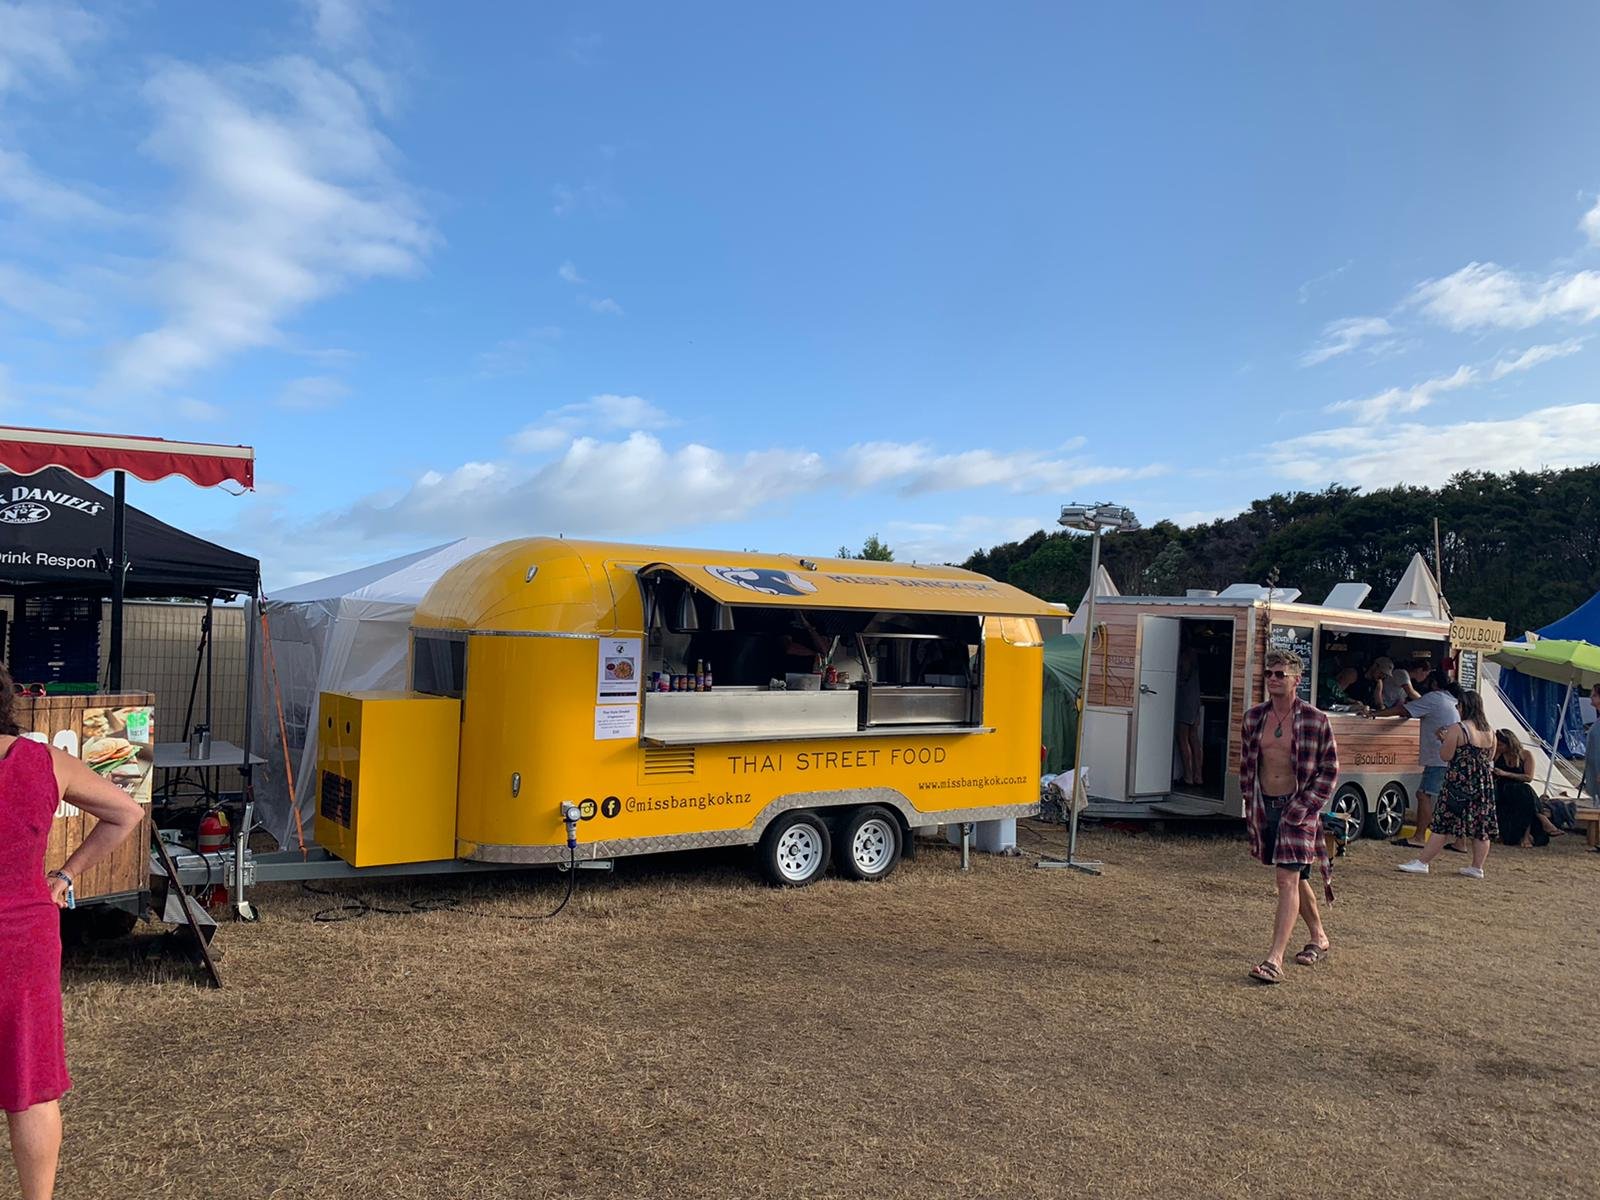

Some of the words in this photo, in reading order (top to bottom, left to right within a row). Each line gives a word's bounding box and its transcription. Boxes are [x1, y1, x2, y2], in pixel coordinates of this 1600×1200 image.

[11, 486, 105, 516] DANIEL'S
[1451, 625, 1502, 643] SOULBOUL
[728, 756, 782, 774] THAI
[796, 750, 880, 771] STREET
[891, 747, 946, 765] FOOD
[1355, 751, 1396, 766] @soulboul
[918, 776, 1027, 790] www.missbangkok.co.nz
[625, 793, 752, 812] @missbangkoknz
